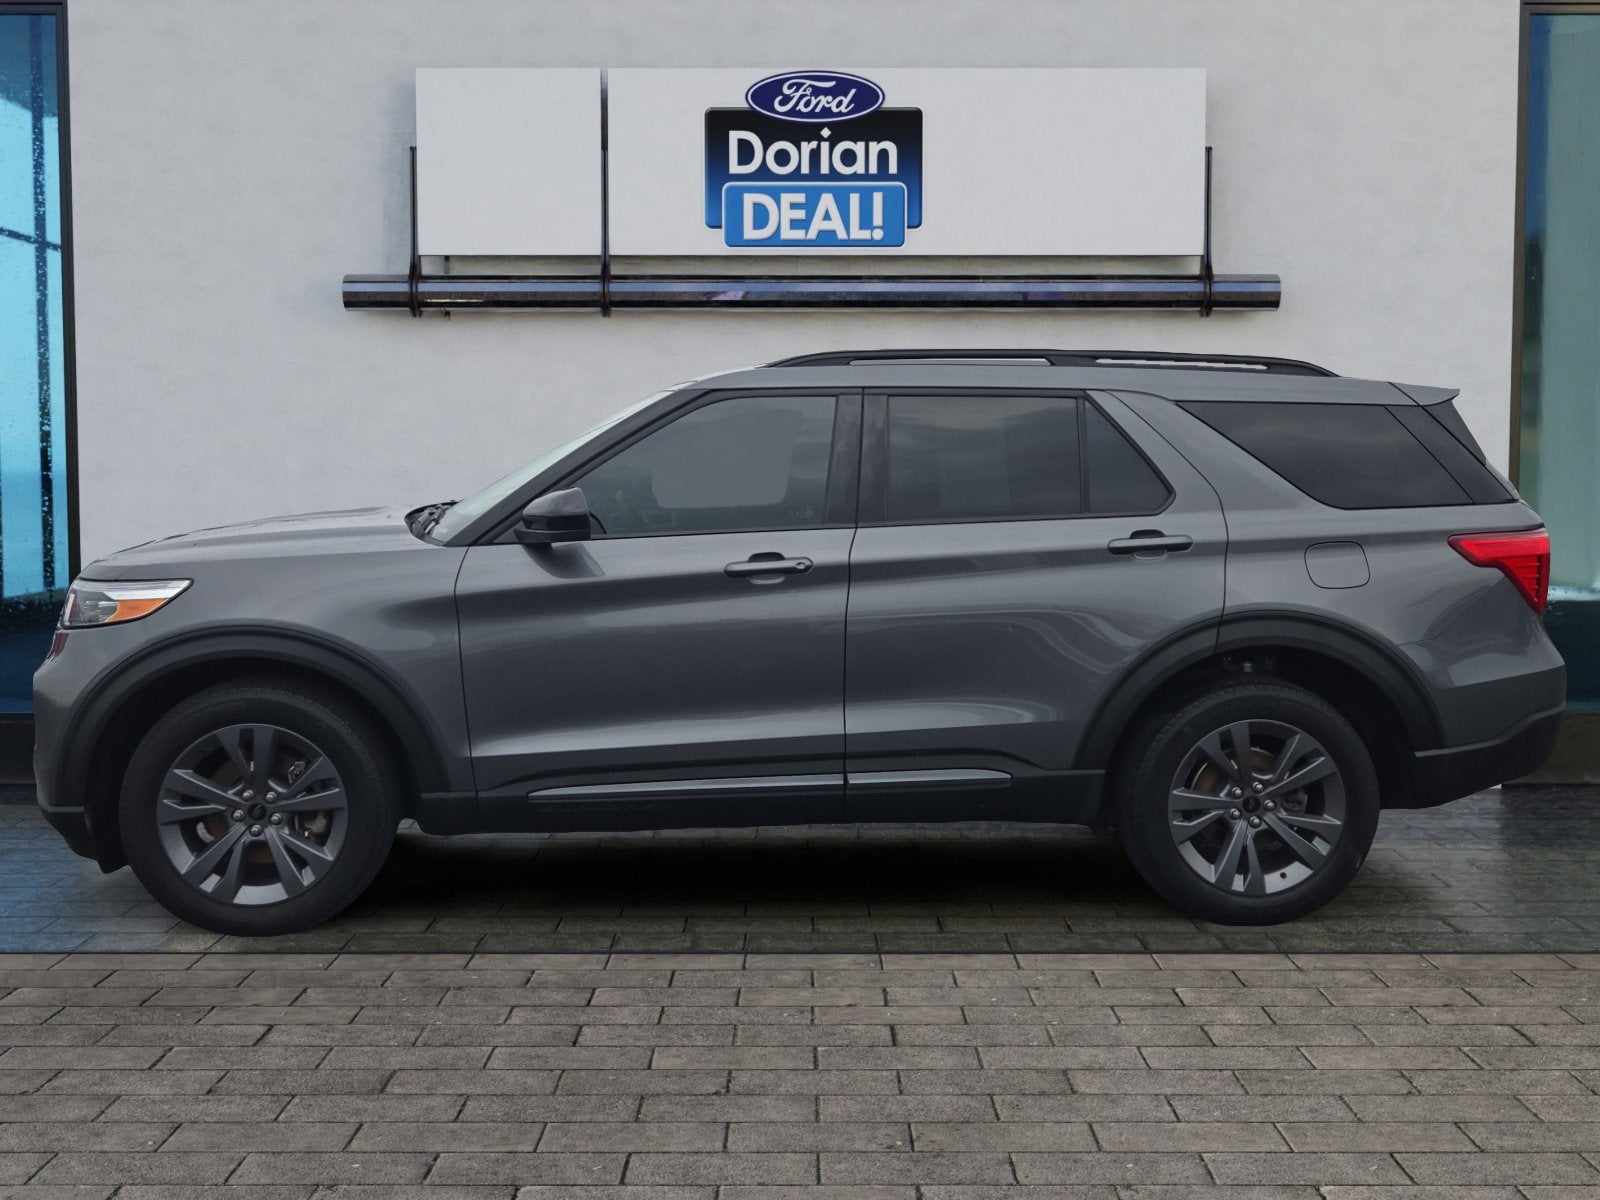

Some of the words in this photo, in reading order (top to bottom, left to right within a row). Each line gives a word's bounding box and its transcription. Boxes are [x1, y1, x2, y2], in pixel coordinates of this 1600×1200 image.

[773, 78, 857, 113] Ford
[728, 127, 898, 175] Dorian
[743, 191, 884, 241] DEAL!
